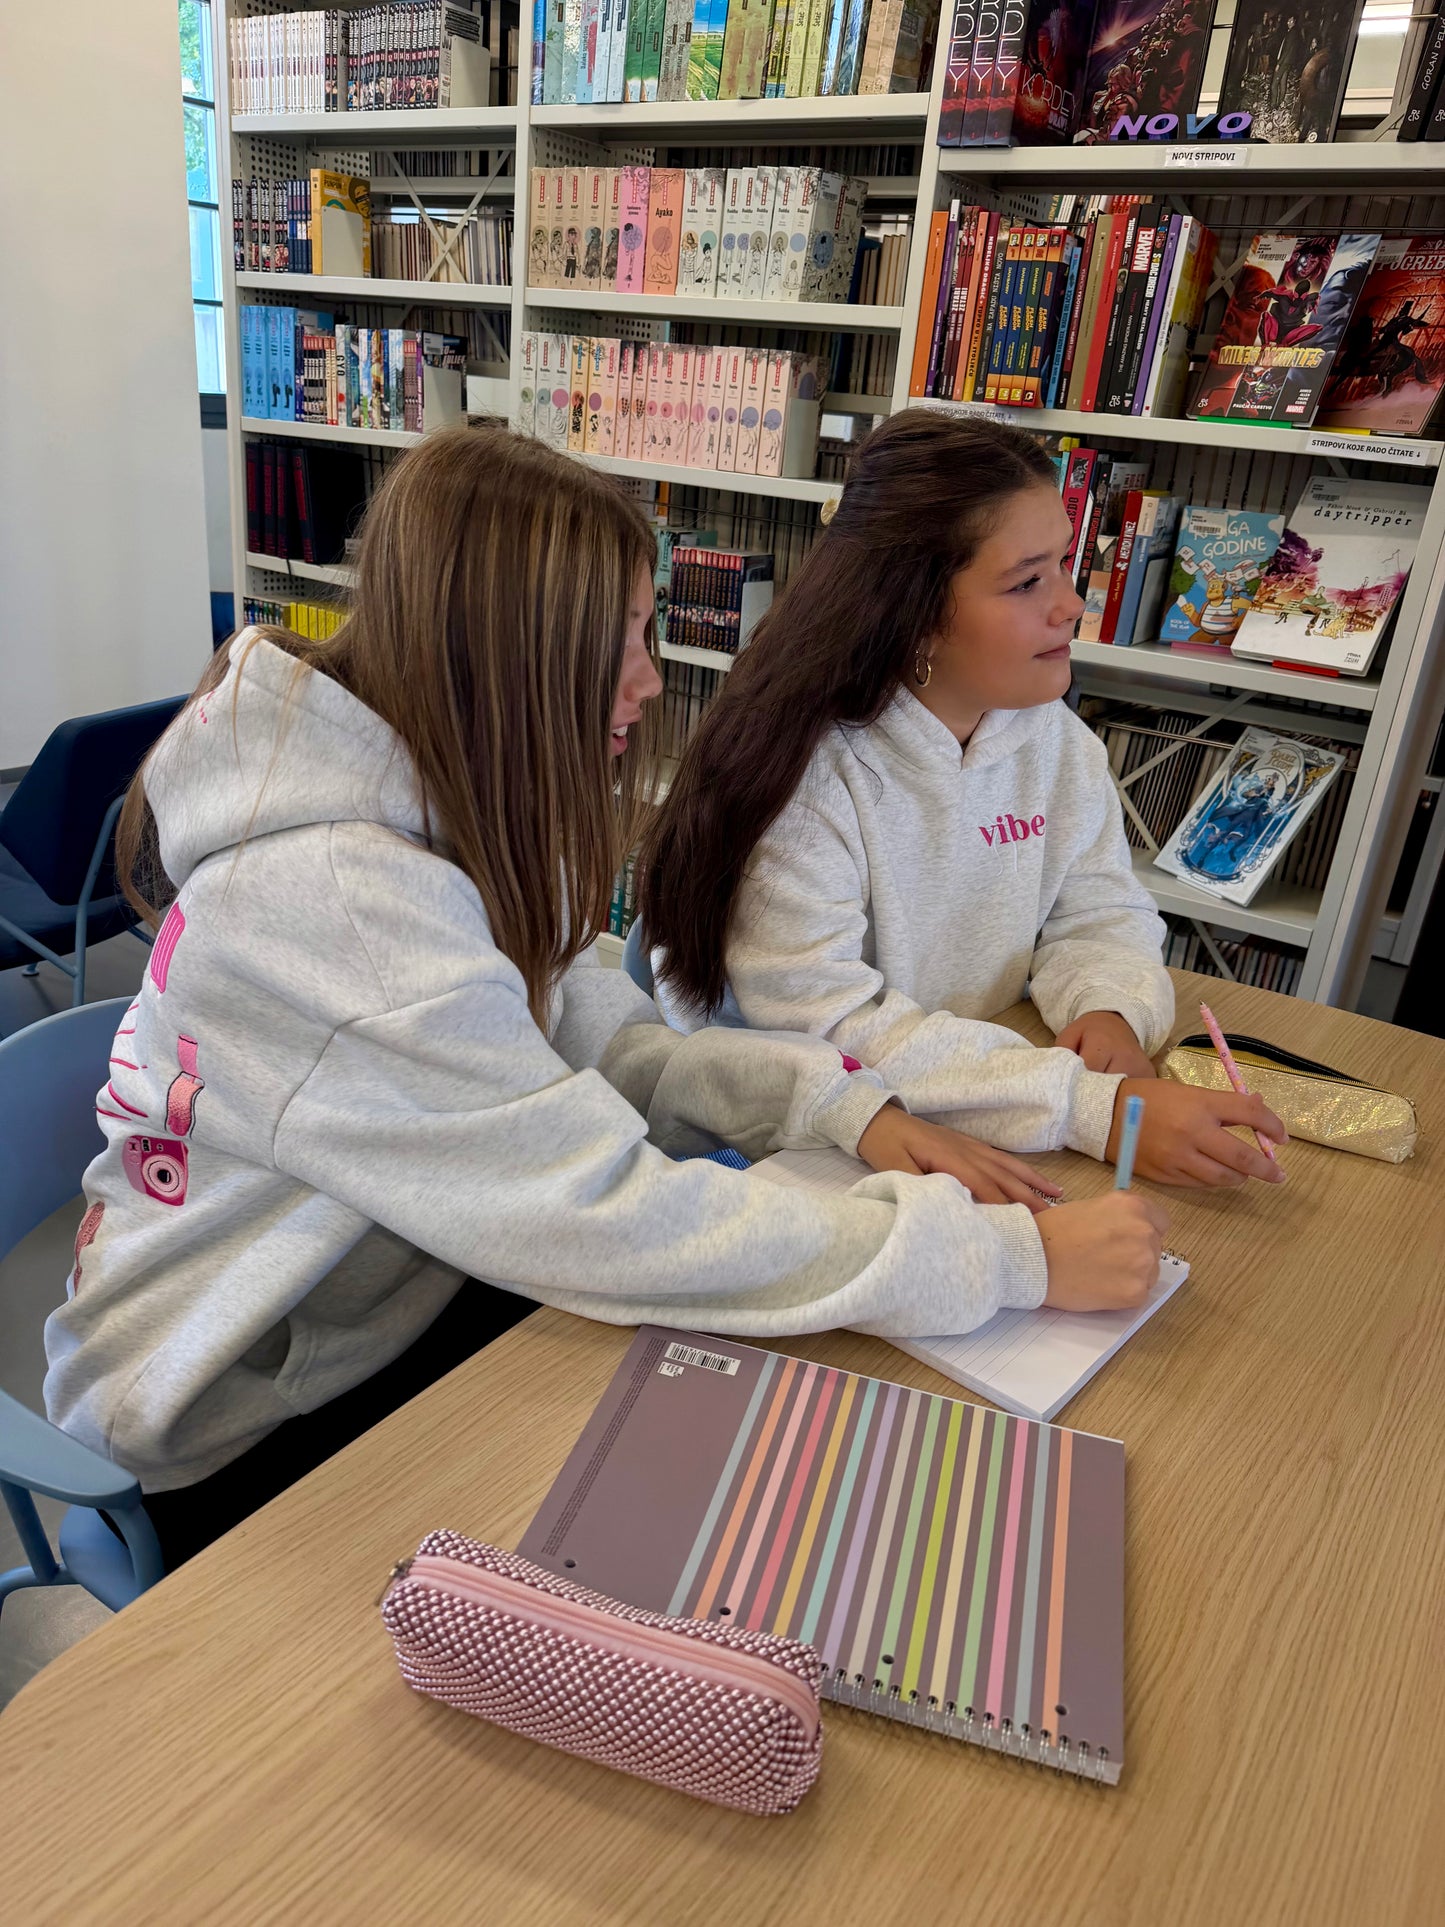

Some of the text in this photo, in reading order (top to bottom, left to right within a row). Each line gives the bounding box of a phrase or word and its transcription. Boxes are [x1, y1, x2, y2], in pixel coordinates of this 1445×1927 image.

[1422, 52, 1439, 90] GORAN
[1021, 68, 1077, 119] KORDEY
[1110, 112, 1253, 137] NOVO
[1171, 152, 1236, 161] NOVI STRIPOVI
[655, 207, 673, 218] Ayako
[984, 236, 995, 271] NEDELJKO
[996, 252, 1004, 269] NOVO
[1133, 229, 1155, 271] MARVEL
[988, 295, 997, 319] ZAPADU
[986, 322, 992, 331] NA
[1119, 343, 1128, 364] AMAZING
[1218, 345, 1261, 365] MILES
[336, 355, 345, 377] GYO
[1312, 439, 1414, 457] STRIPOVI KOJE RADO ČITATE
[1314, 506, 1412, 527] daytripper
[1373, 507, 1396, 515] Gabriel
[1202, 535, 1267, 559] GODINE
[978, 813, 1045, 847] vibe
